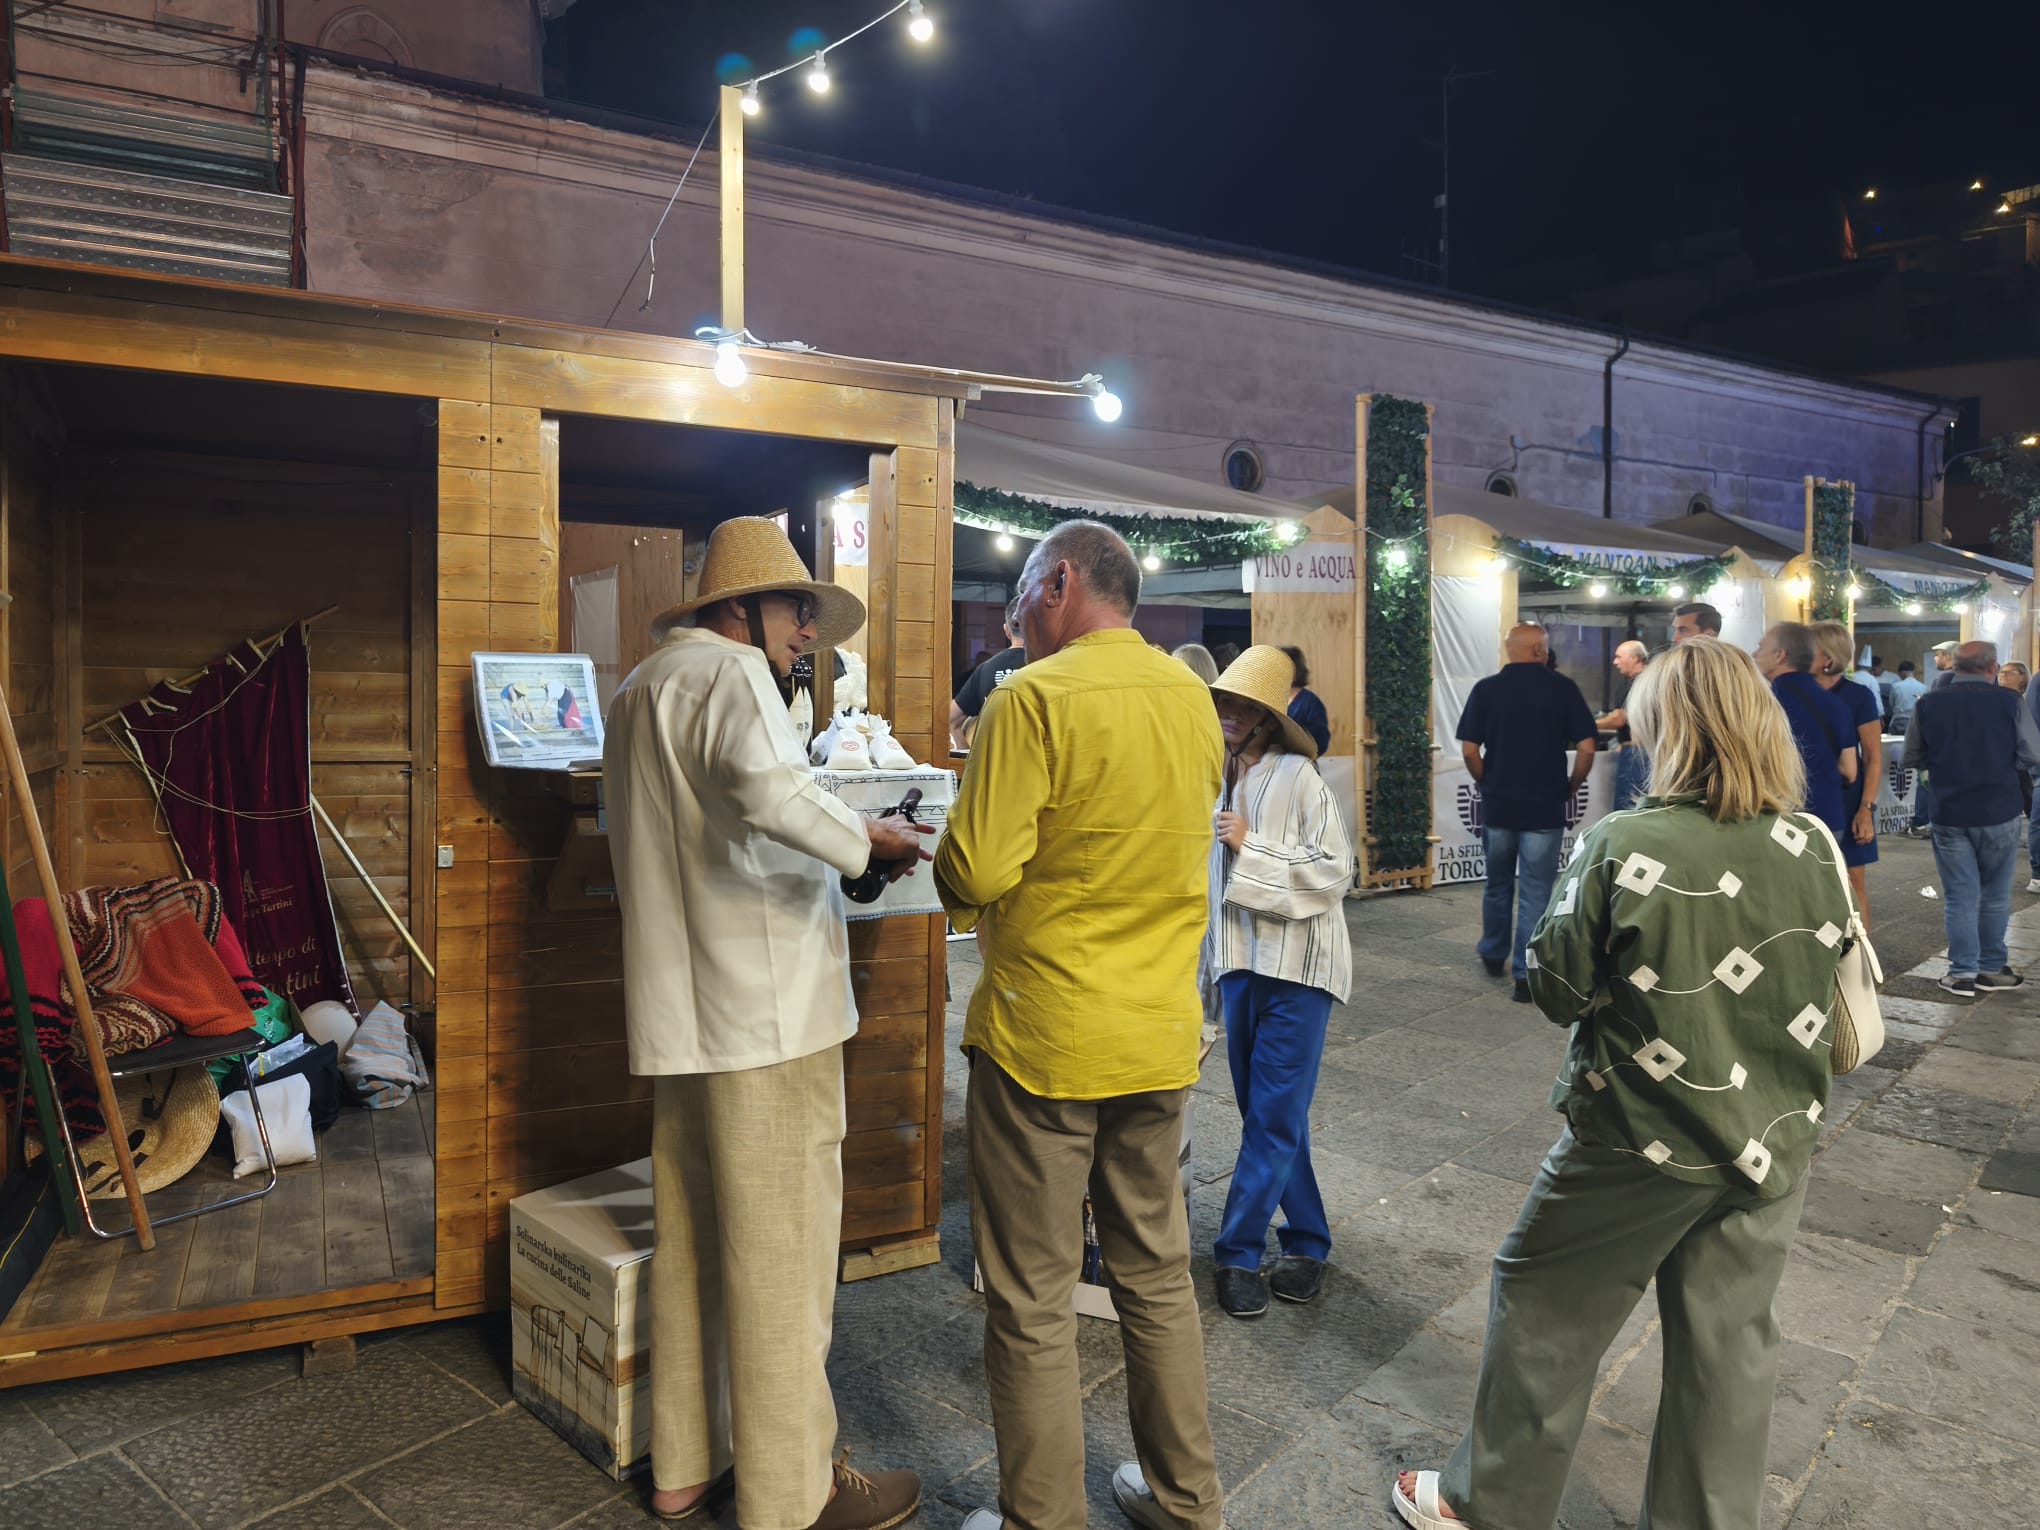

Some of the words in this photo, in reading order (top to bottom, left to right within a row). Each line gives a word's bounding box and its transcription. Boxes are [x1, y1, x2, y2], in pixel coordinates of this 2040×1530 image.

[1254, 554, 1291, 578] VINO
[1296, 561, 1304, 578] e
[1308, 555, 1356, 583] ACQUA
[1439, 846, 1455, 860] LA
[1457, 844, 1485, 858] SFID
[261, 898, 293, 913] Tartini
[301, 935, 317, 954] di
[516, 1225, 553, 1258] Solinarska
[553, 1247, 592, 1283] kulinarika
[517, 1242, 525, 1257] La
[526, 1251, 549, 1273] cucina
[549, 1263, 567, 1285] delle
[567, 1276, 591, 1301] Saline
